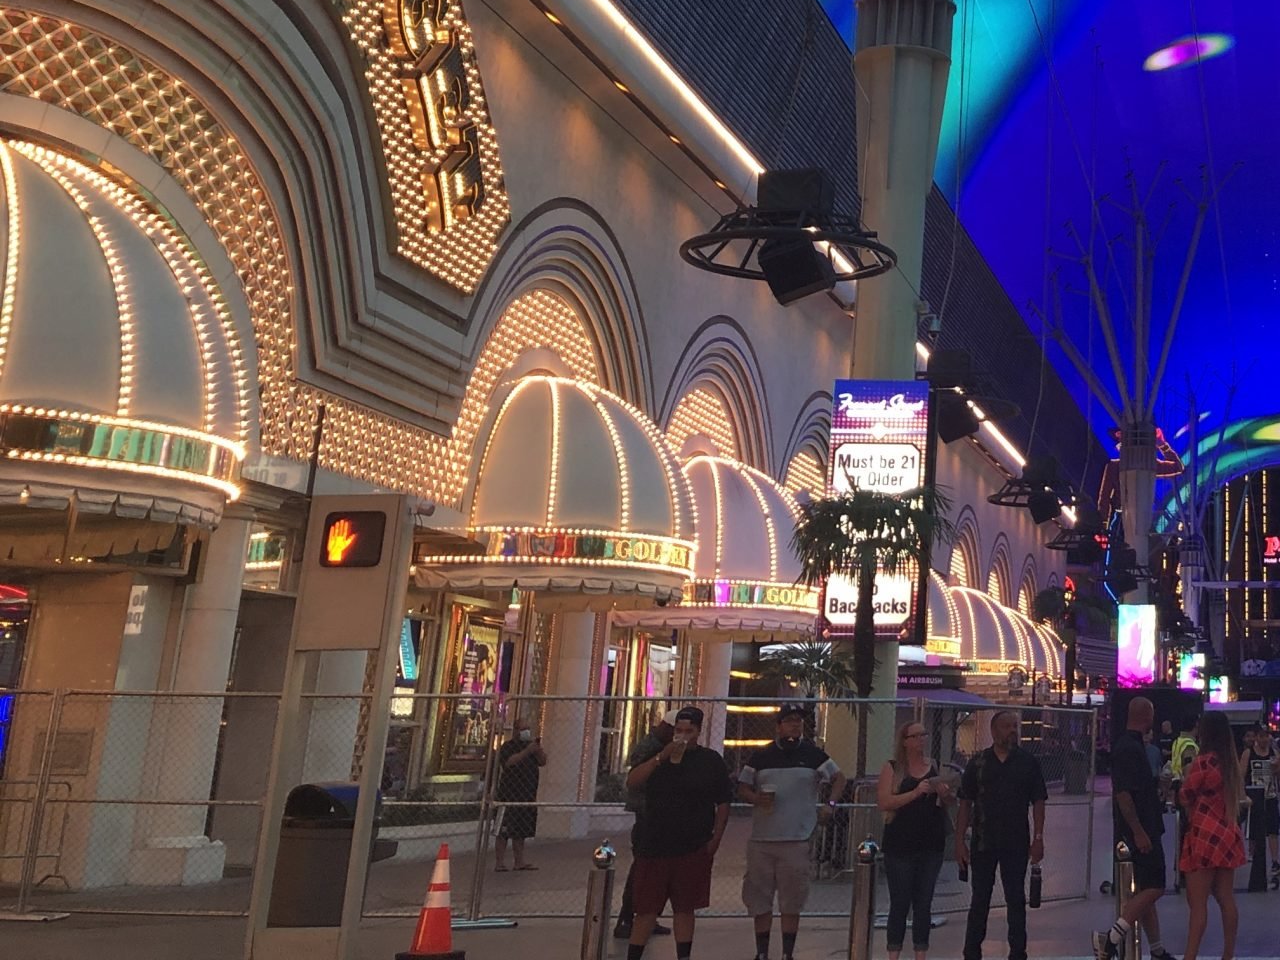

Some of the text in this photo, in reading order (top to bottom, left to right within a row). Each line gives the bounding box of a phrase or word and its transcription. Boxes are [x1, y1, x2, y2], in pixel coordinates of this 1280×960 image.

[837, 453, 916, 469] Must be 21
[867, 471, 905, 486] Older
[829, 597, 908, 615] Bacacks
